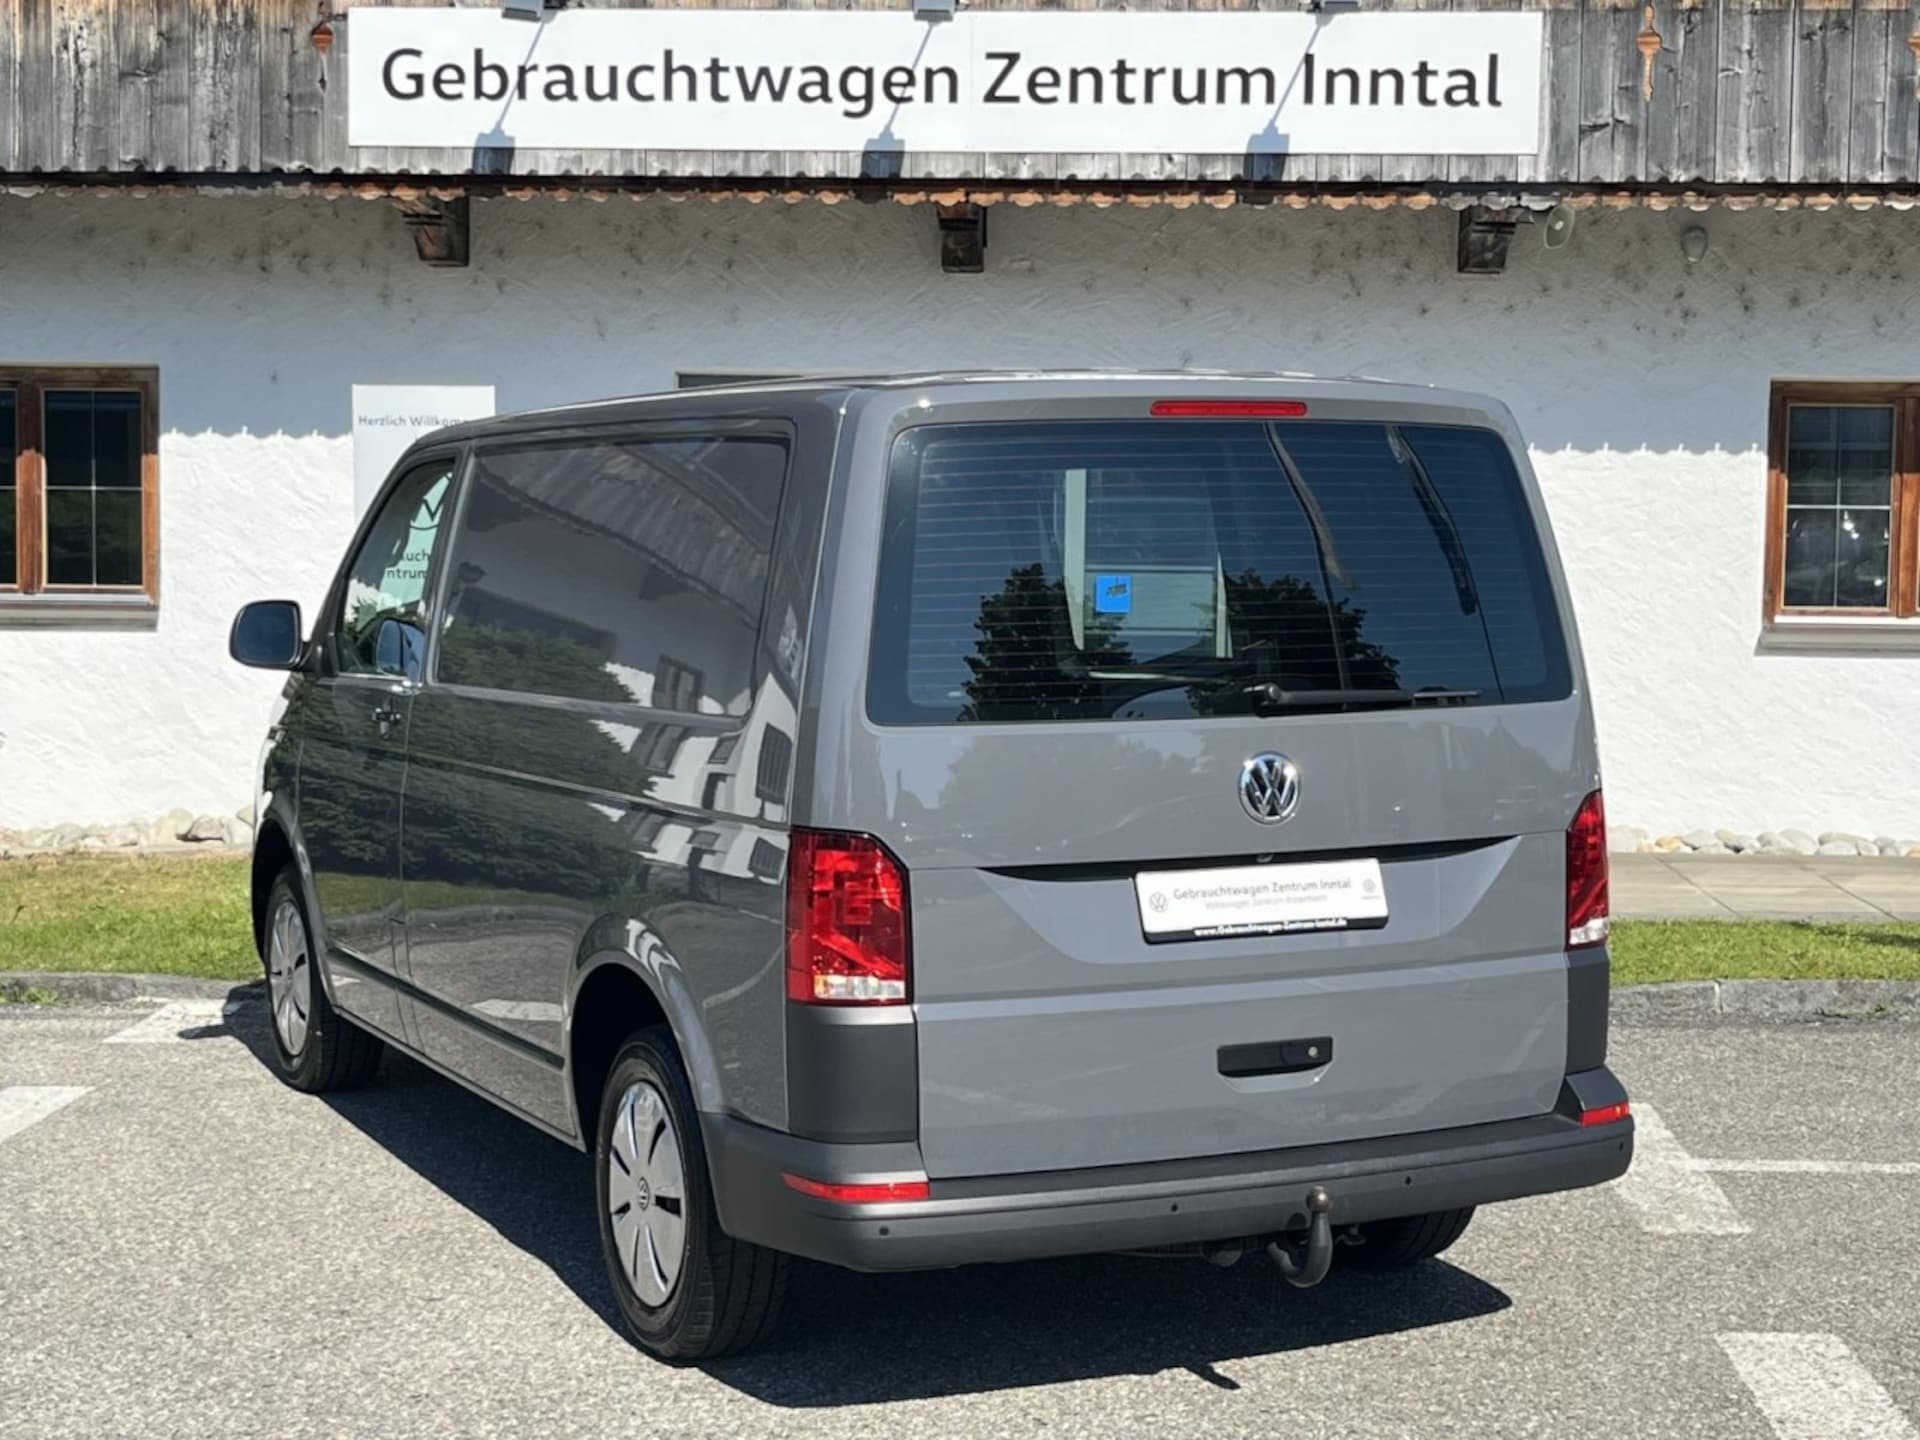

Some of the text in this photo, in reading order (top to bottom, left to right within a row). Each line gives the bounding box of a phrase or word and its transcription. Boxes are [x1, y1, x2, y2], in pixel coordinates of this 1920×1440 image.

[382, 47, 1503, 119] Gebrauchtwagen Zentrum Inntal
[358, 415, 468, 427] Herzlich Willkom
[1173, 883, 1270, 901] Gebrauchtwagen
[1272, 880, 1318, 893] Zentrum
